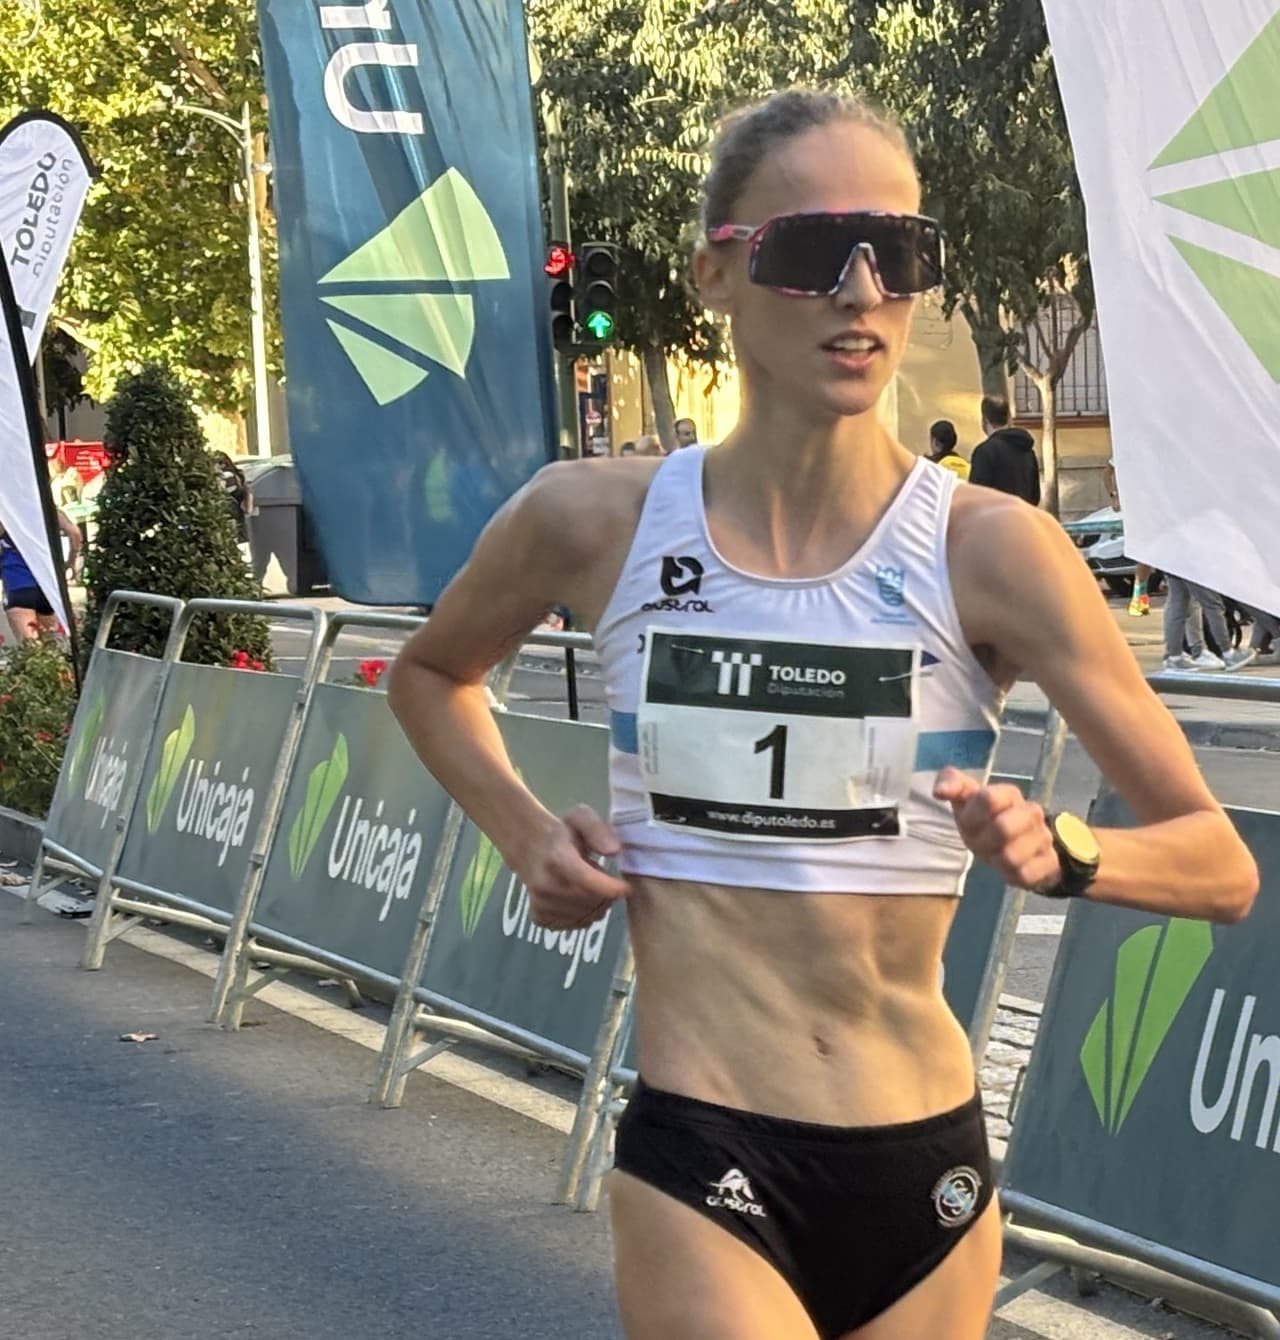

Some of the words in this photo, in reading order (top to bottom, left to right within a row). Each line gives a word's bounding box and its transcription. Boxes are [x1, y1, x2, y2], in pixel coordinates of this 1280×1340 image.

[767, 682, 845, 699] Diputación
[769, 665, 846, 685] TOLEDO
[754, 725, 788, 800] 1
[177, 759, 254, 867] Unicaja
[706, 811, 836, 831] www.diputoledo.es
[328, 796, 422, 922] Unicaja
